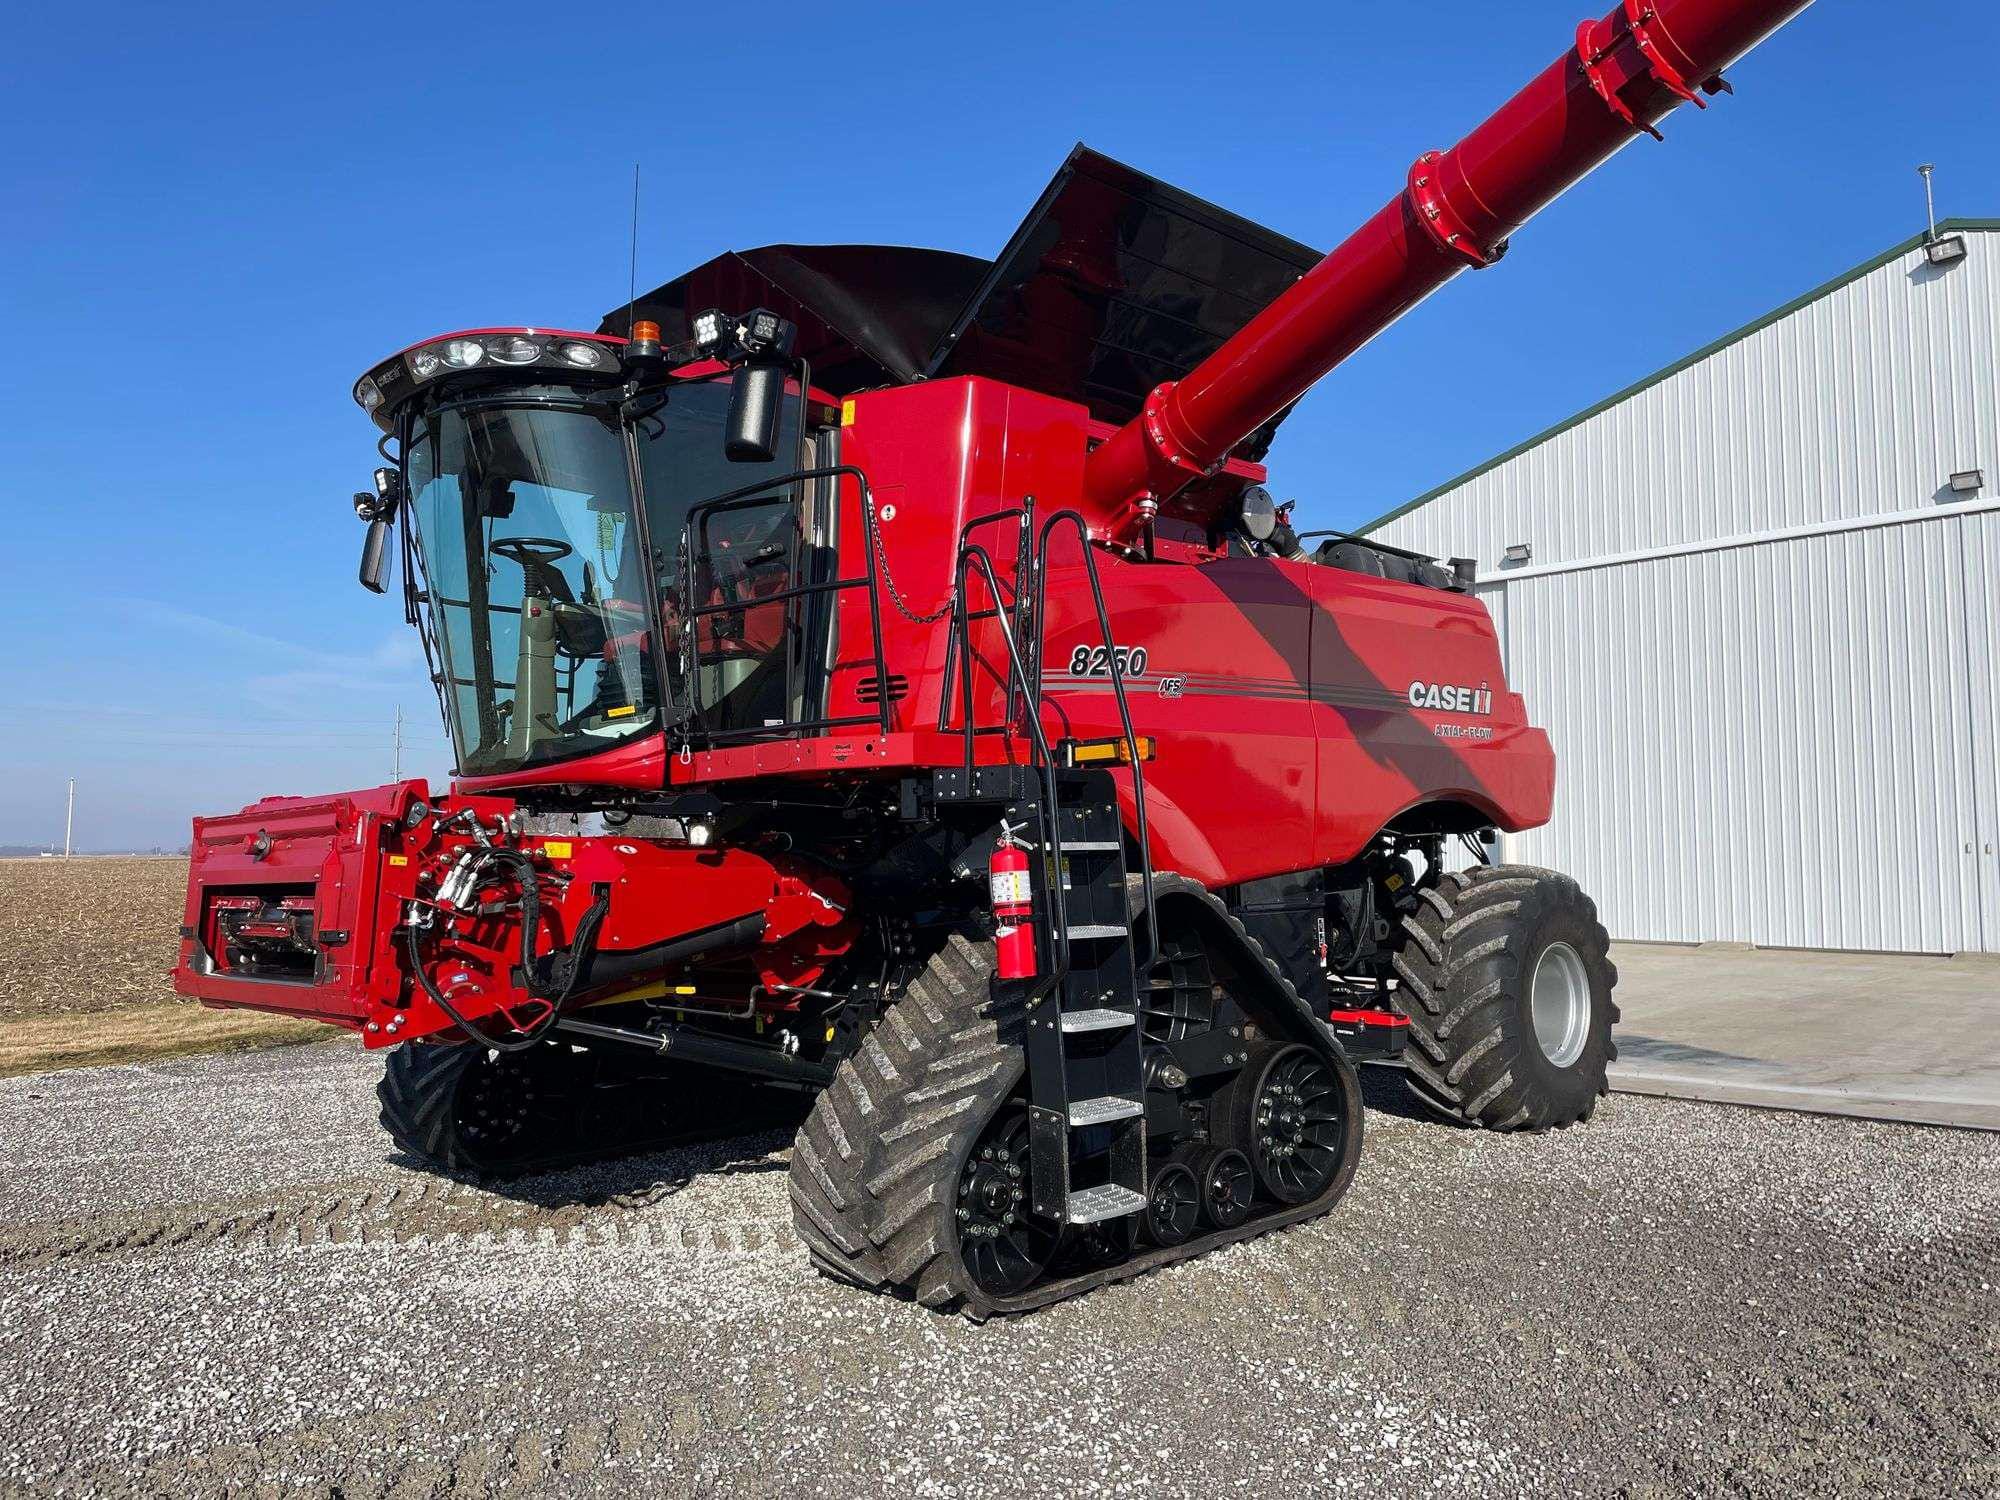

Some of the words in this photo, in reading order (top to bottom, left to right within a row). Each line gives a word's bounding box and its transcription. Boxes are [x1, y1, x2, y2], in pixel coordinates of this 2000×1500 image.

[1069, 644, 1148, 678] 8250
[1158, 677, 1182, 692] AFS
[1408, 680, 1471, 712] CASE
[1434, 723, 1493, 740] AXIAL-FLOW
